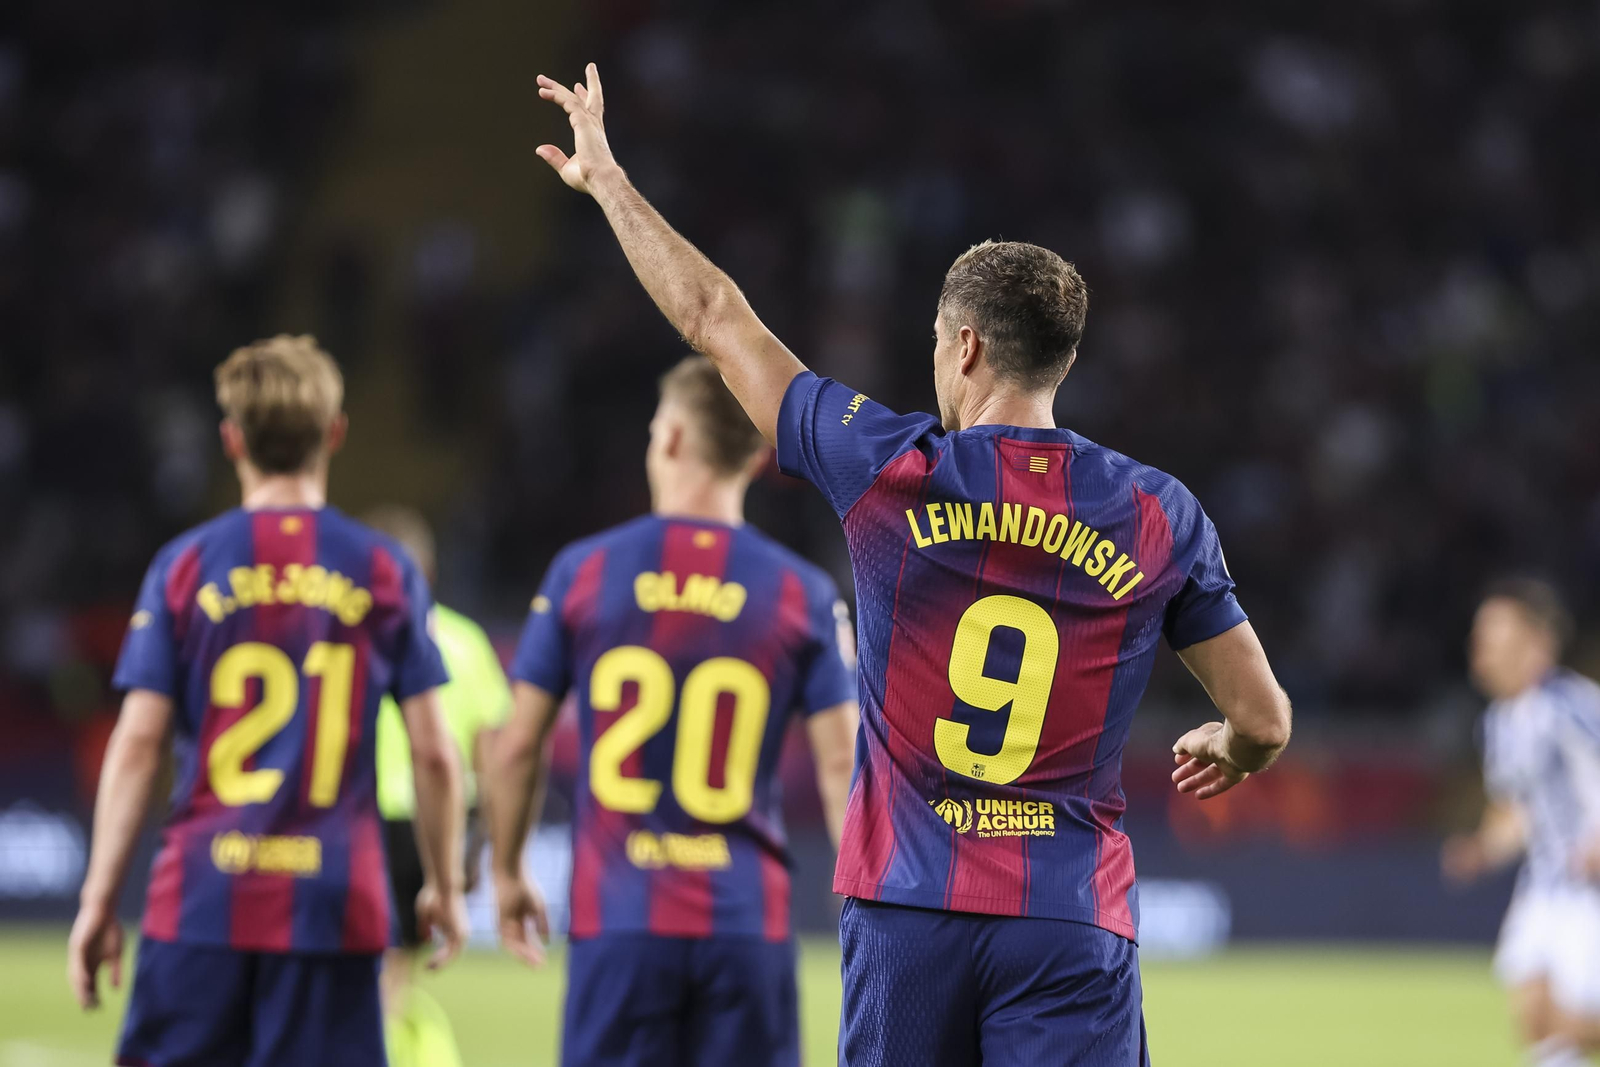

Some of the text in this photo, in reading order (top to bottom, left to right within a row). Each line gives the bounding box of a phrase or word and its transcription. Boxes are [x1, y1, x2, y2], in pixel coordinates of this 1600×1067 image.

[841, 414, 854, 426] tv
[905, 502, 1145, 601] LEWANDOWSKI
[634, 571, 747, 624] OLMO
[933, 594, 1060, 786] 9
[208, 641, 356, 807] 21
[589, 645, 771, 825] 20
[976, 799, 1054, 815] UNHCR
[976, 815, 1055, 830] ACNUR
[991, 830, 1002, 838] UN
[1030, 829, 1055, 837] Agency
